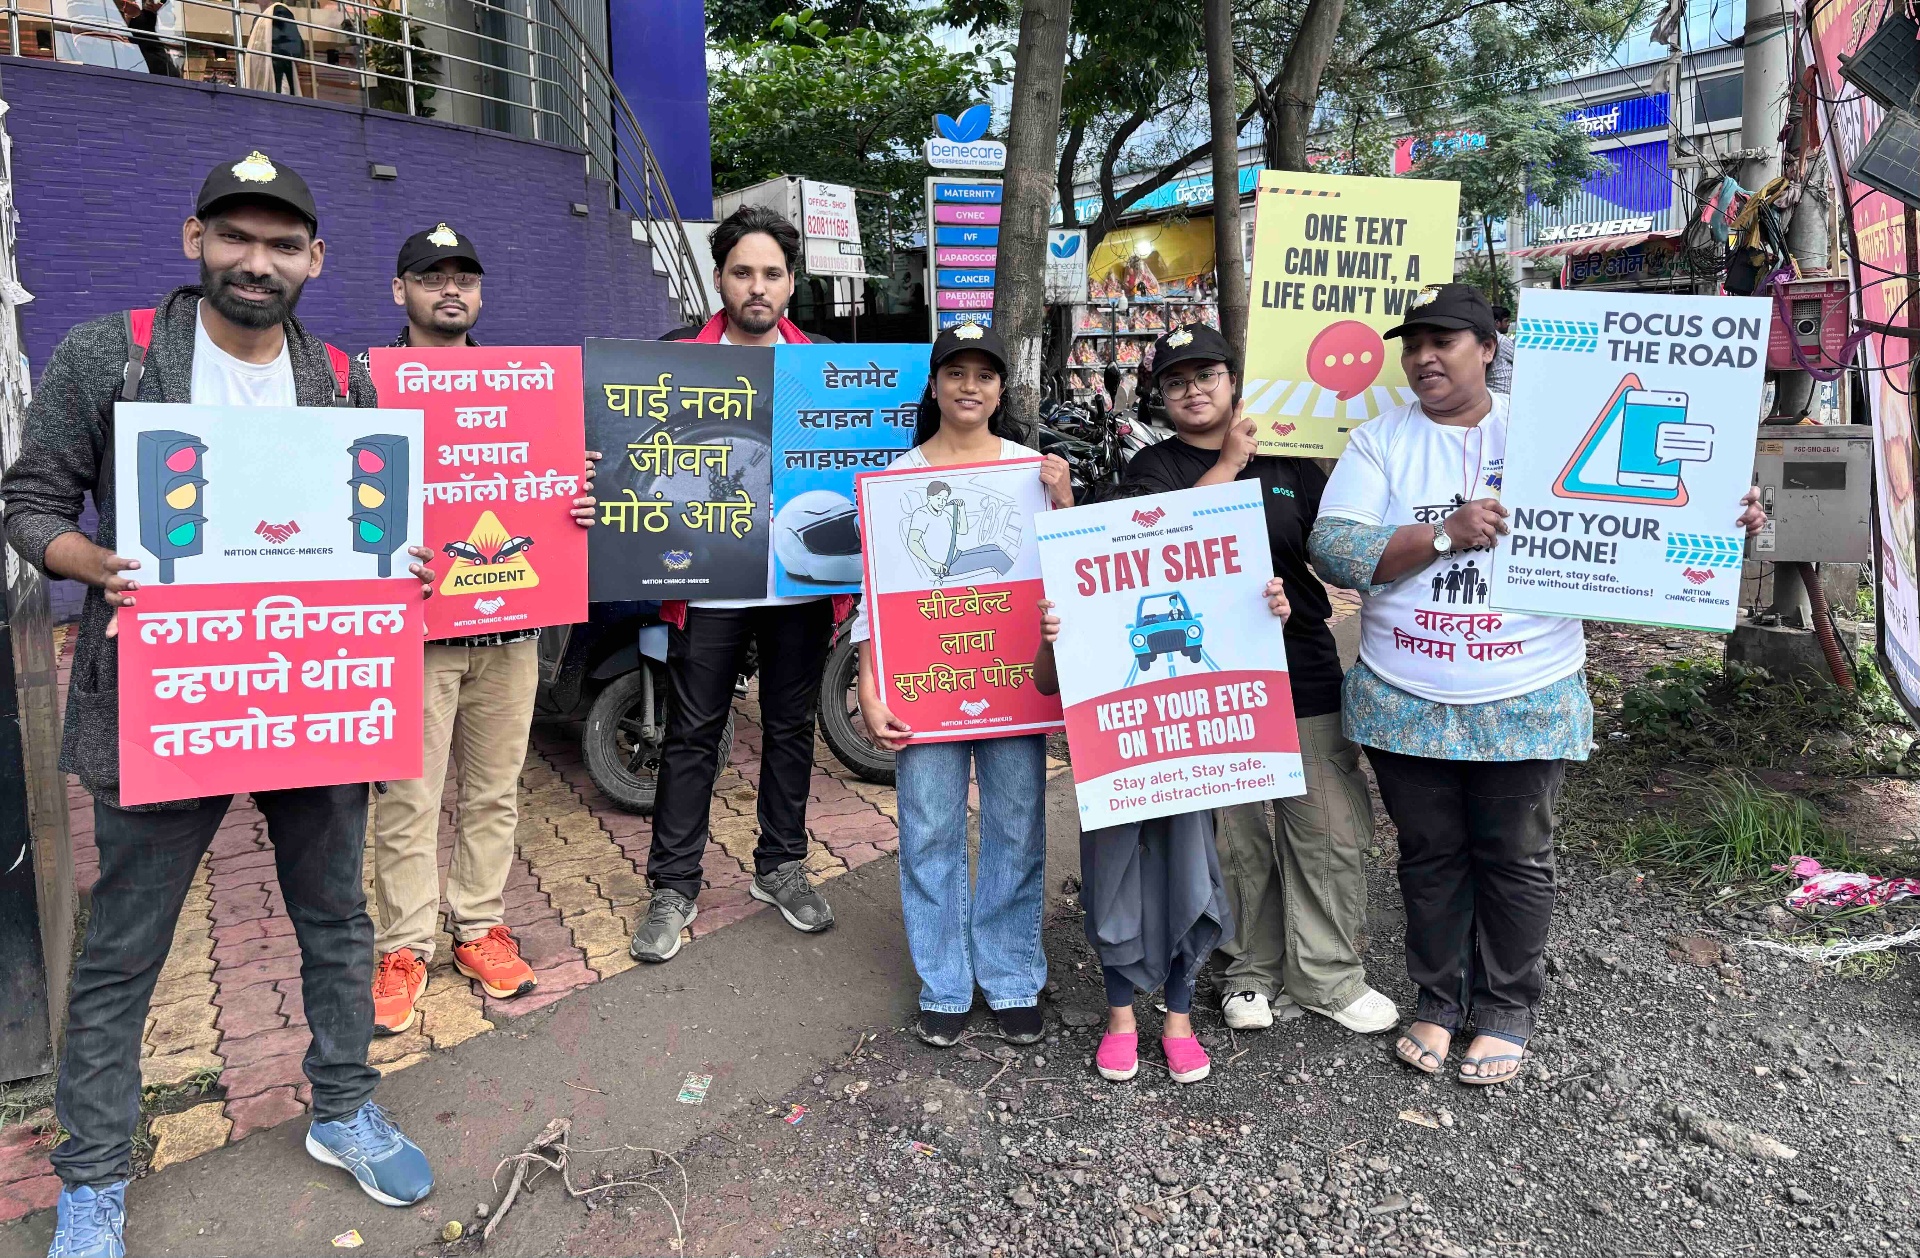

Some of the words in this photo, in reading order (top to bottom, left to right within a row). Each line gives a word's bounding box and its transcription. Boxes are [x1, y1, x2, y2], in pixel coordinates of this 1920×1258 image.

[931, 142, 1003, 159] benecare
[931, 158, 978, 166] SUPERSPECIALITY
[808, 197, 828, 207] OFFICE
[832, 200, 847, 210] SHOP
[944, 189, 996, 198] MATERNITY
[808, 215, 849, 237] 8208111695
[956, 211, 985, 220] GYNEC
[1539, 216, 1653, 241] SKECHERS
[963, 233, 978, 241] IVF
[1304, 213, 1348, 243] ONE
[1354, 216, 1408, 246] TEXT
[1284, 247, 1329, 277] CAN
[1336, 250, 1397, 284] WAIT,
[1405, 254, 1420, 282] A
[1573, 252, 1603, 281] हरि
[1605, 250, 1646, 277] ओम
[954, 275, 990, 283] CANCER
[945, 292, 994, 300] PAEDIATRIC
[958, 300, 965, 308] &
[1262, 281, 1305, 310] LIFE
[1312, 284, 1376, 314] CAN'T
[955, 313, 991, 321] GENERAL
[1604, 311, 1703, 338] FOCUS
[1712, 316, 1761, 341] ON
[1608, 339, 1660, 364] THE
[1669, 344, 1758, 369] ROAD
[396, 362, 478, 393] नियम
[482, 361, 554, 392] फॉलो
[823, 361, 898, 389] हेलमेट
[603, 373, 673, 422] घाई
[679, 376, 757, 421] नको
[455, 406, 507, 429] करा
[798, 409, 874, 430] स्टाइल
[438, 442, 529, 466] अपघात
[627, 431, 733, 477] जीवन
[1274, 441, 1324, 450] CHANGE-MAKERS
[1488, 459, 1504, 467] NAT
[512, 469, 579, 502] होईल
[599, 489, 673, 534] मोठं
[680, 490, 757, 539] आहे
[1513, 507, 1574, 530] NOT
[1578, 512, 1661, 541] YOUR
[1112, 534, 1136, 543] NATION
[1137, 525, 1194, 539] CHANGE-MAKERS
[224, 548, 257, 556] NATION
[259, 547, 333, 556] CHANGE-MAKERS
[1510, 534, 1618, 565] PHONE!
[454, 569, 526, 588] ACCIDENT
[1075, 547, 1150, 597] STAY
[1162, 535, 1242, 583] SAFE
[1508, 565, 1532, 578] Stay
[1533, 567, 1564, 580] alert,
[1565, 571, 1591, 583] stay
[1592, 572, 1620, 584] safe.
[1507, 575, 1536, 587] Drive
[1537, 577, 1580, 591] without
[1582, 580, 1654, 597] distractions!
[1682, 588, 1711, 597] NATION
[917, 586, 1012, 620] सीटबेल्ट
[1665, 593, 1730, 606] CHANGE-MAKERS
[137, 609, 245, 644] लाल
[252, 595, 406, 640] सिग्नल
[454, 618, 476, 627] NATION
[477, 614, 527, 626] CHANGE-MAKERS
[1414, 609, 1503, 641] वाहतूक
[939, 629, 996, 655] लावा
[1393, 626, 1456, 662] नियम
[1467, 640, 1526, 662] पाळा
[152, 651, 292, 703] म्हणजे
[301, 647, 395, 691] थांबा
[893, 663, 977, 702] सुरक्षित
[1096, 698, 1148, 732] KEEP
[1153, 688, 1210, 721] YOUR
[1214, 680, 1268, 712] EYES
[151, 707, 297, 757] तडजोड
[304, 698, 396, 745] नाही
[964, 715, 1013, 726] CHANGE-MAKERS
[1118, 728, 1147, 760] ON
[1151, 723, 1193, 754] THE
[1198, 714, 1256, 746] ROAD
[1113, 774, 1147, 792] Stay
[1150, 767, 1189, 786] alert,
[1192, 762, 1227, 779] Stay
[1229, 758, 1266, 773] safe.
[1109, 793, 1148, 811] Drive
[1151, 774, 1275, 804] distraction-free!!
